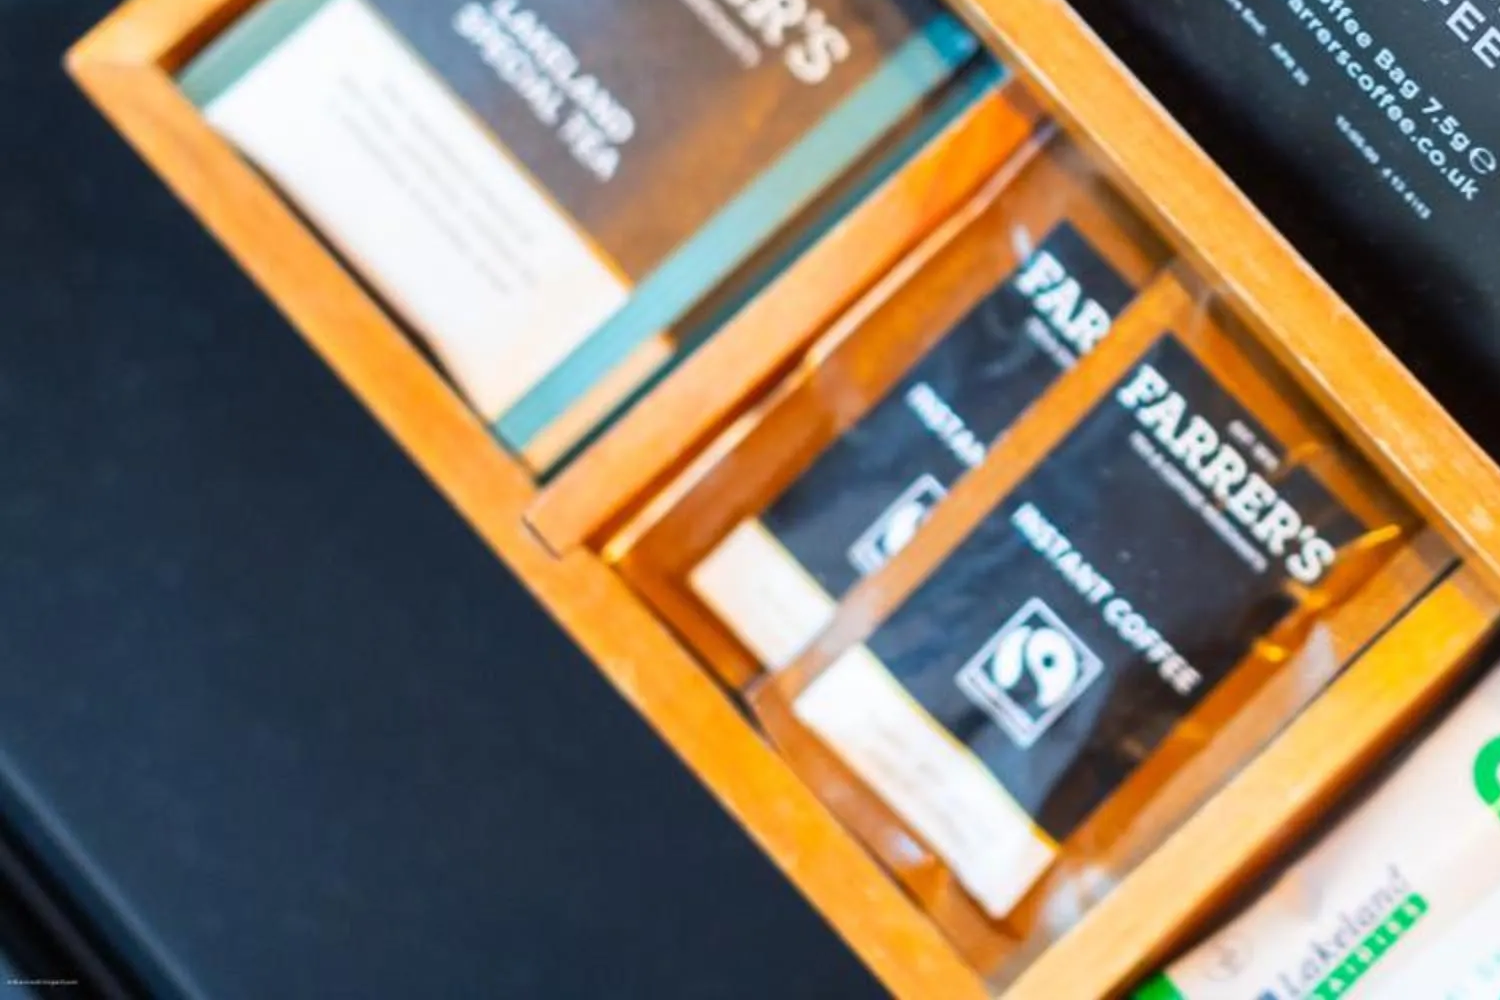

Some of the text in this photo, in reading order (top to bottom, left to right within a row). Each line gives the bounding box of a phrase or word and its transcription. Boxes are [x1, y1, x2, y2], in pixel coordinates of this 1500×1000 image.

[1374, 48, 1420, 101] Bag
[1116, 364, 1335, 583] FARRER'S
[1102, 597, 1201, 695] COFFEE
